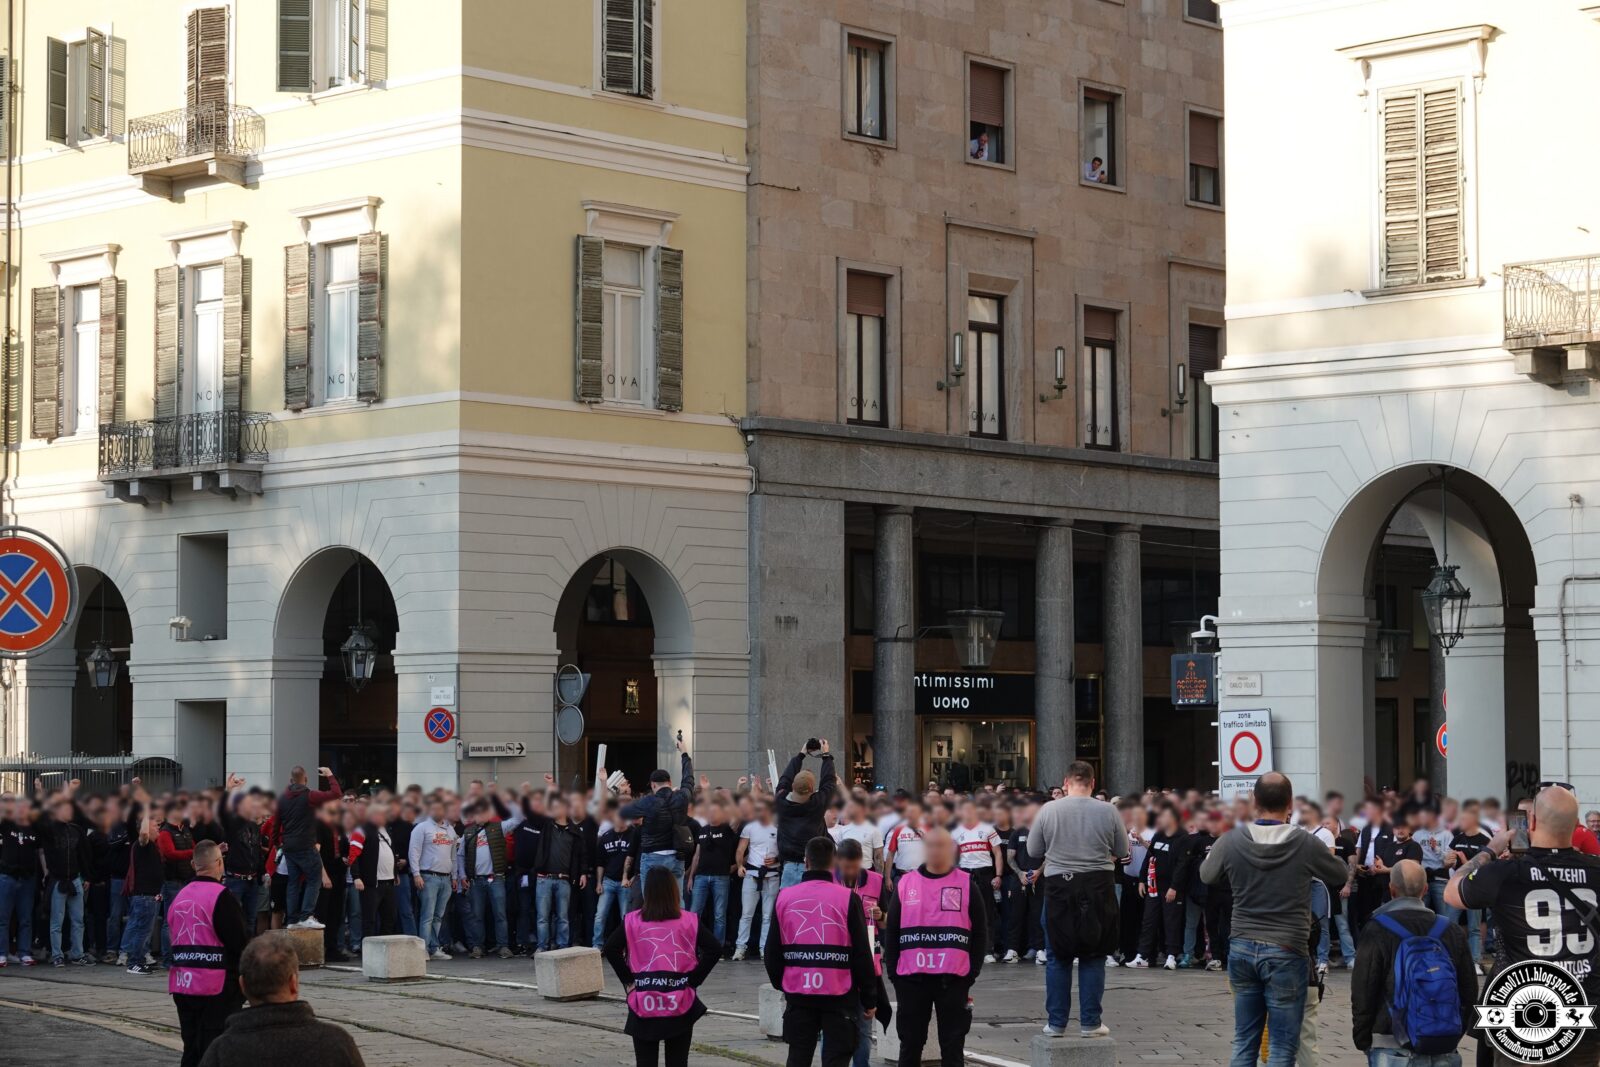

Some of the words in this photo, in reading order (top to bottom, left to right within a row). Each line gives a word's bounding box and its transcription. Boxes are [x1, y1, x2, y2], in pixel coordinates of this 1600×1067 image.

[328, 371, 357, 385] NOV
[607, 374, 638, 387] OVA
[196, 390, 223, 401] NOV
[850, 396, 878, 409] OVA
[972, 410, 997, 422] OVA
[1086, 423, 1110, 435] OVA
[914, 673, 994, 689] ntimissimi
[933, 697, 970, 709] UOMO
[604, 839, 630, 850] ULTR
[1524, 888, 1598, 956] 93
[921, 934, 937, 942] FAN
[799, 952, 815, 960] FAN
[916, 951, 946, 968] 017
[634, 977, 651, 987] TING
[651, 977, 668, 987] FAN
[668, 976, 689, 987] SUPP
[643, 994, 679, 1012] 013
